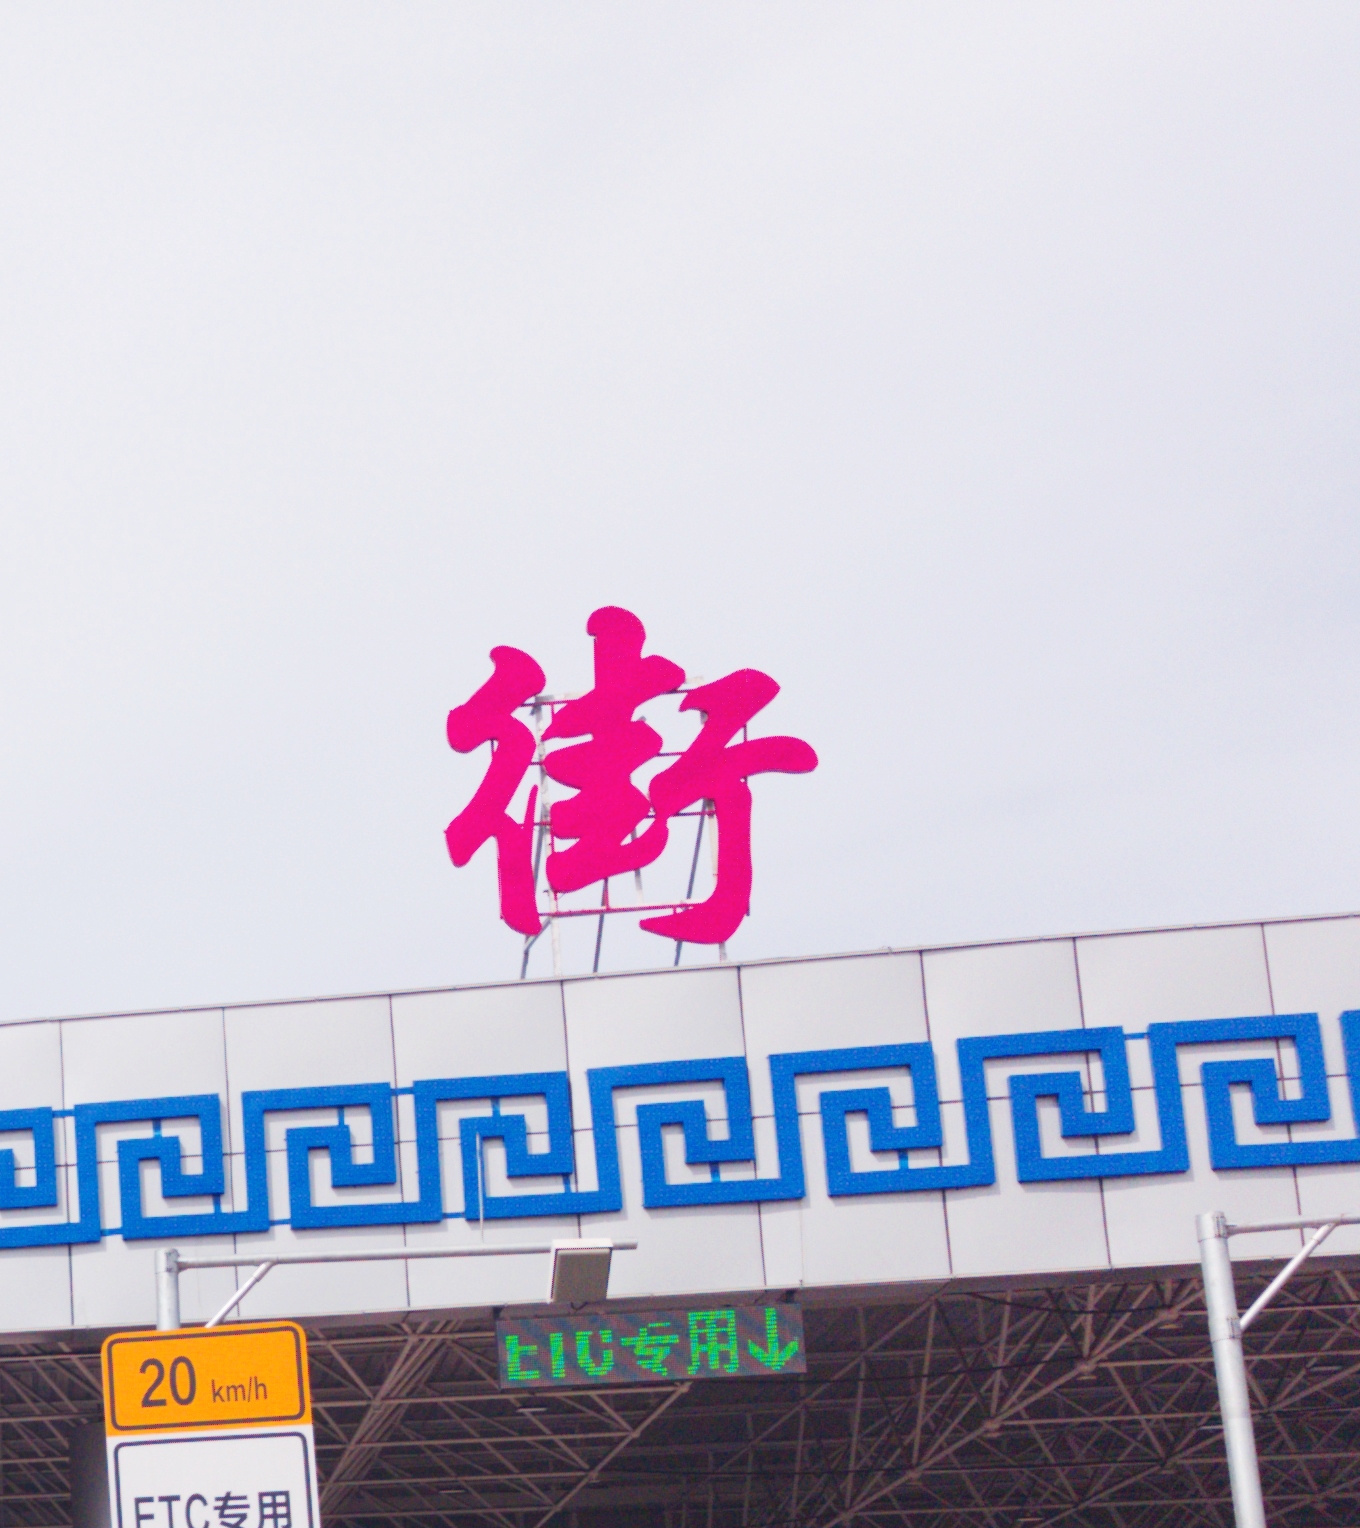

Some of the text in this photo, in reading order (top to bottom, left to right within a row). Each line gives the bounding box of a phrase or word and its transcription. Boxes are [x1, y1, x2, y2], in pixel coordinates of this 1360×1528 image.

[444, 605, 819, 945] 街
[139, 1355, 268, 1408] 20 km/h
